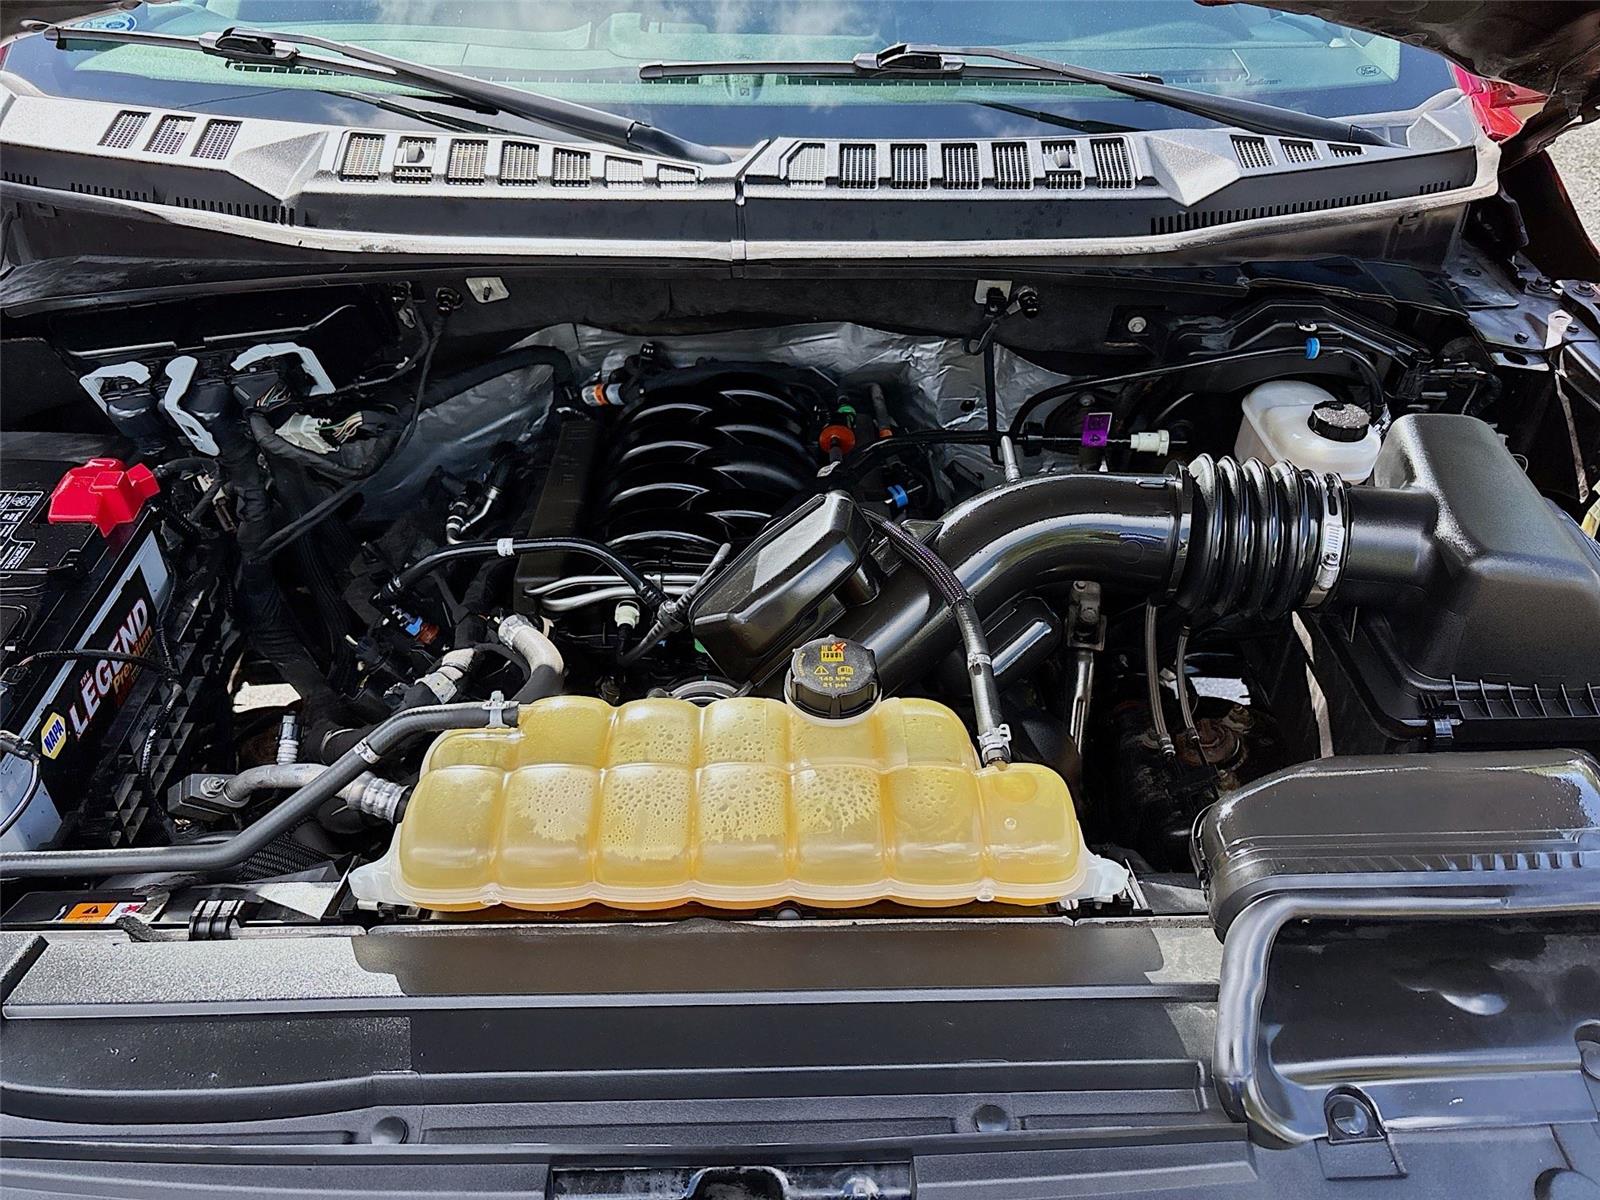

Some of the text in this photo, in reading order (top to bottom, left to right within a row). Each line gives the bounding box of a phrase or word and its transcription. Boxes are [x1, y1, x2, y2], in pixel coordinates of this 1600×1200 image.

[69, 598, 148, 738] LEGEND
[113, 625, 153, 695] Preium
[43, 719, 65, 754] NAPA
